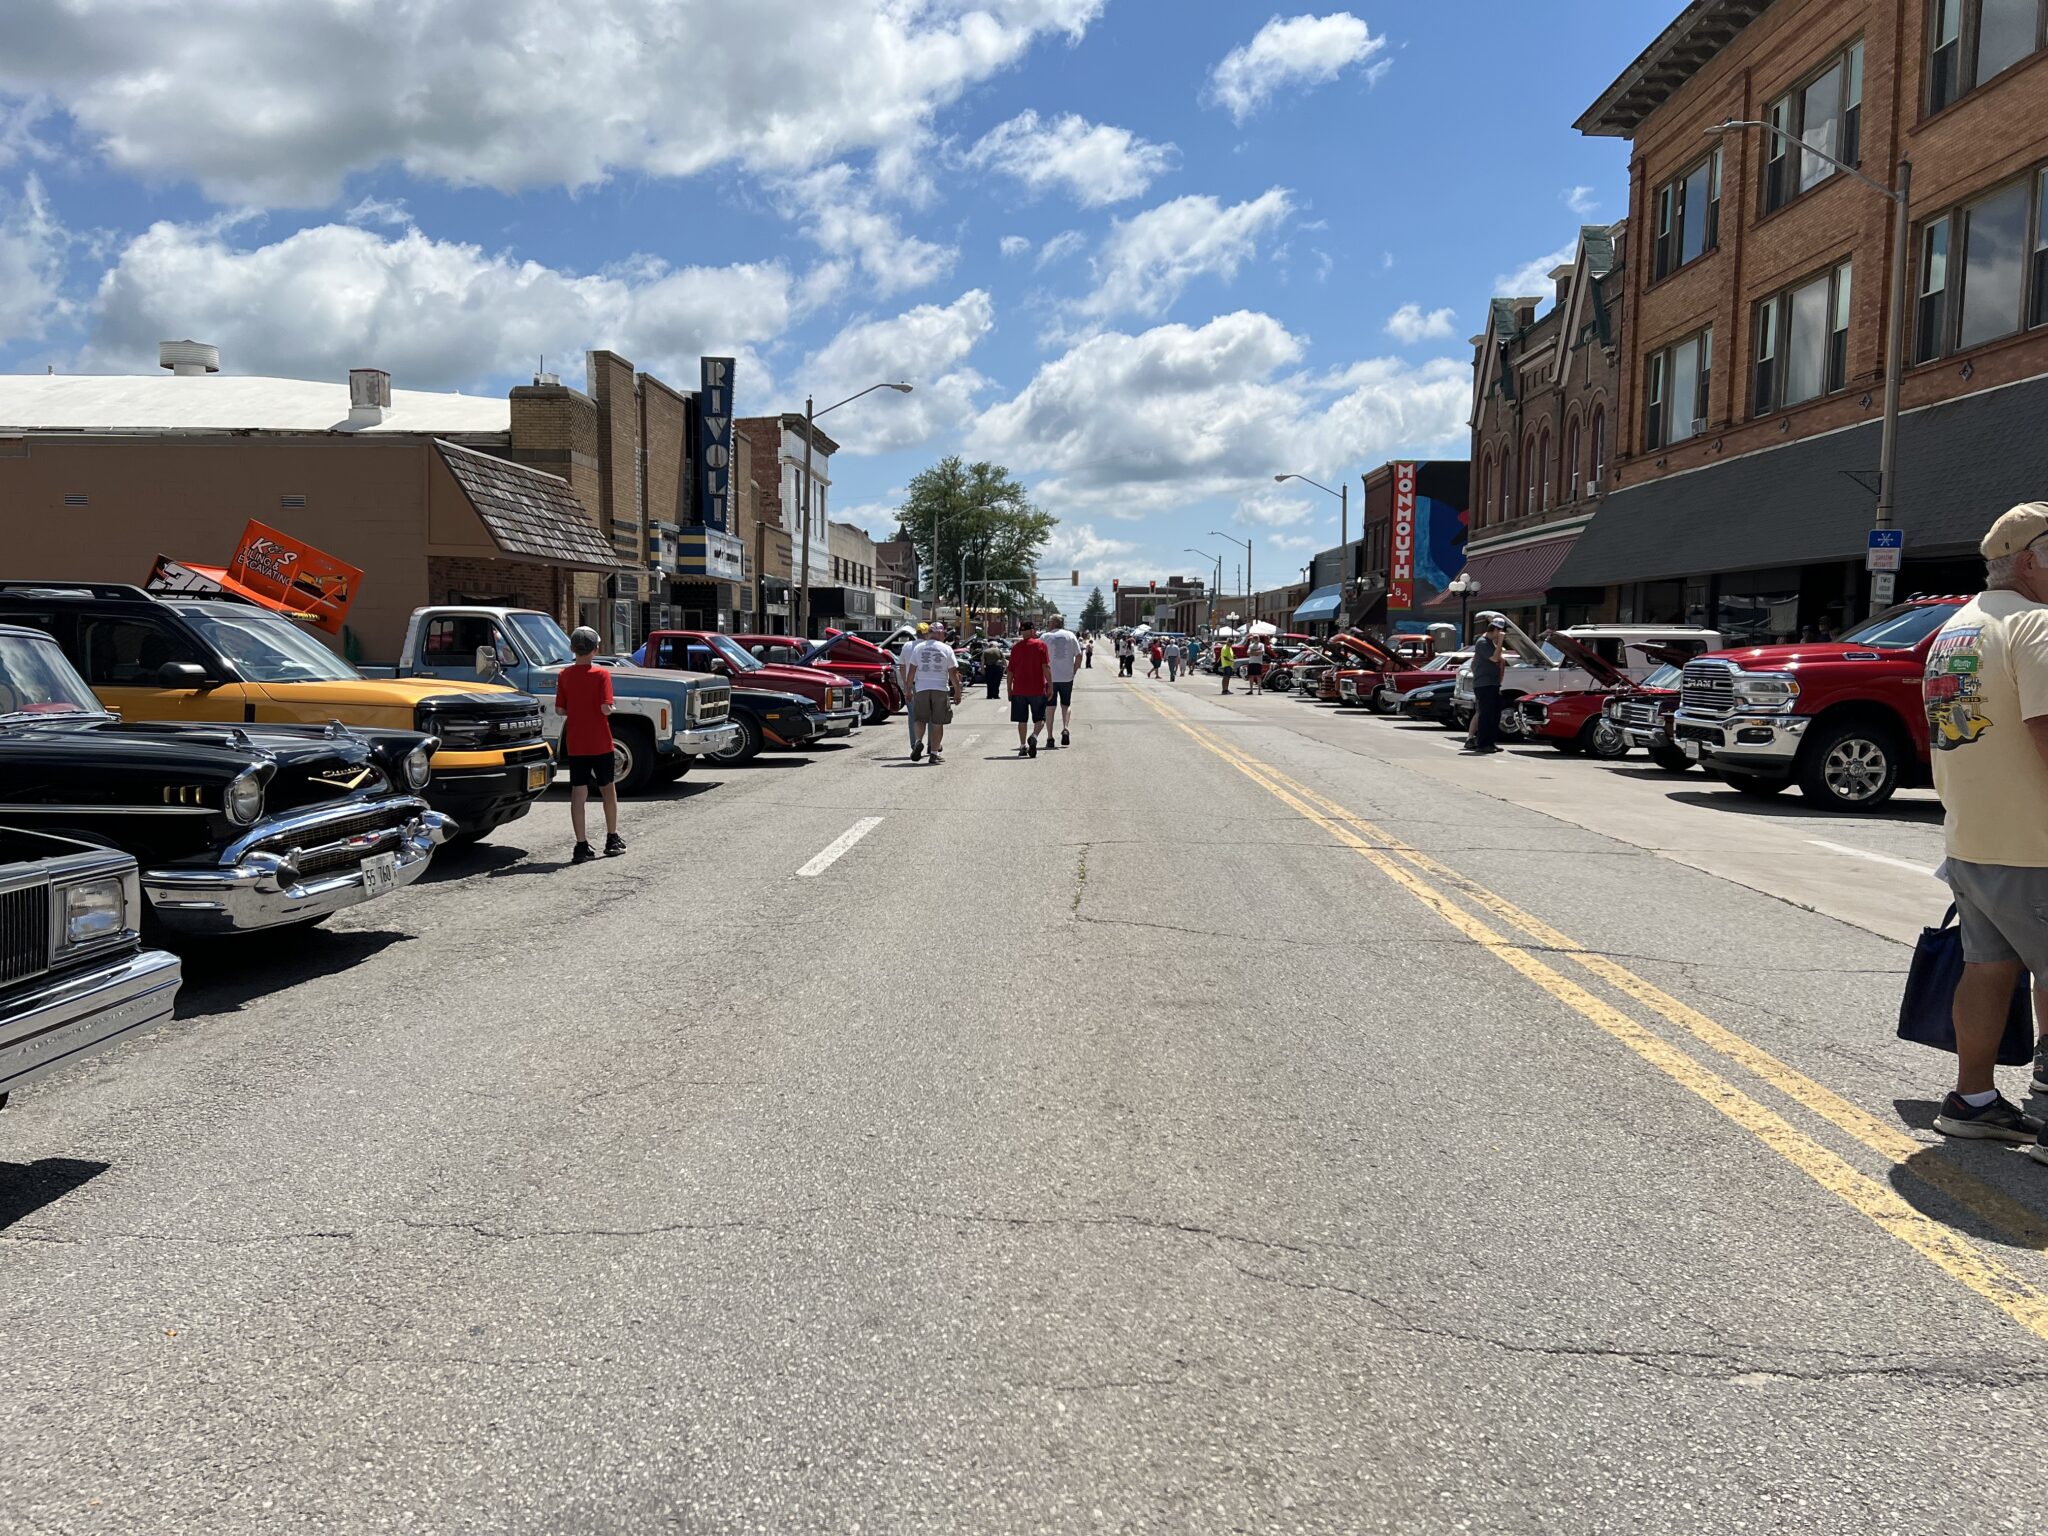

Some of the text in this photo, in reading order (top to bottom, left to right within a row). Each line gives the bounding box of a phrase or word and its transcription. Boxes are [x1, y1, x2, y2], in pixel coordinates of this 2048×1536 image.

[704, 361, 728, 522] RIVOLI
[1394, 464, 1414, 579] MONMOUTH
[236, 554, 292, 587] EXCAVATING
[1392, 582, 1411, 607] 1831
[1686, 680, 1712, 688] RAM
[499, 719, 543, 730] BRONCO
